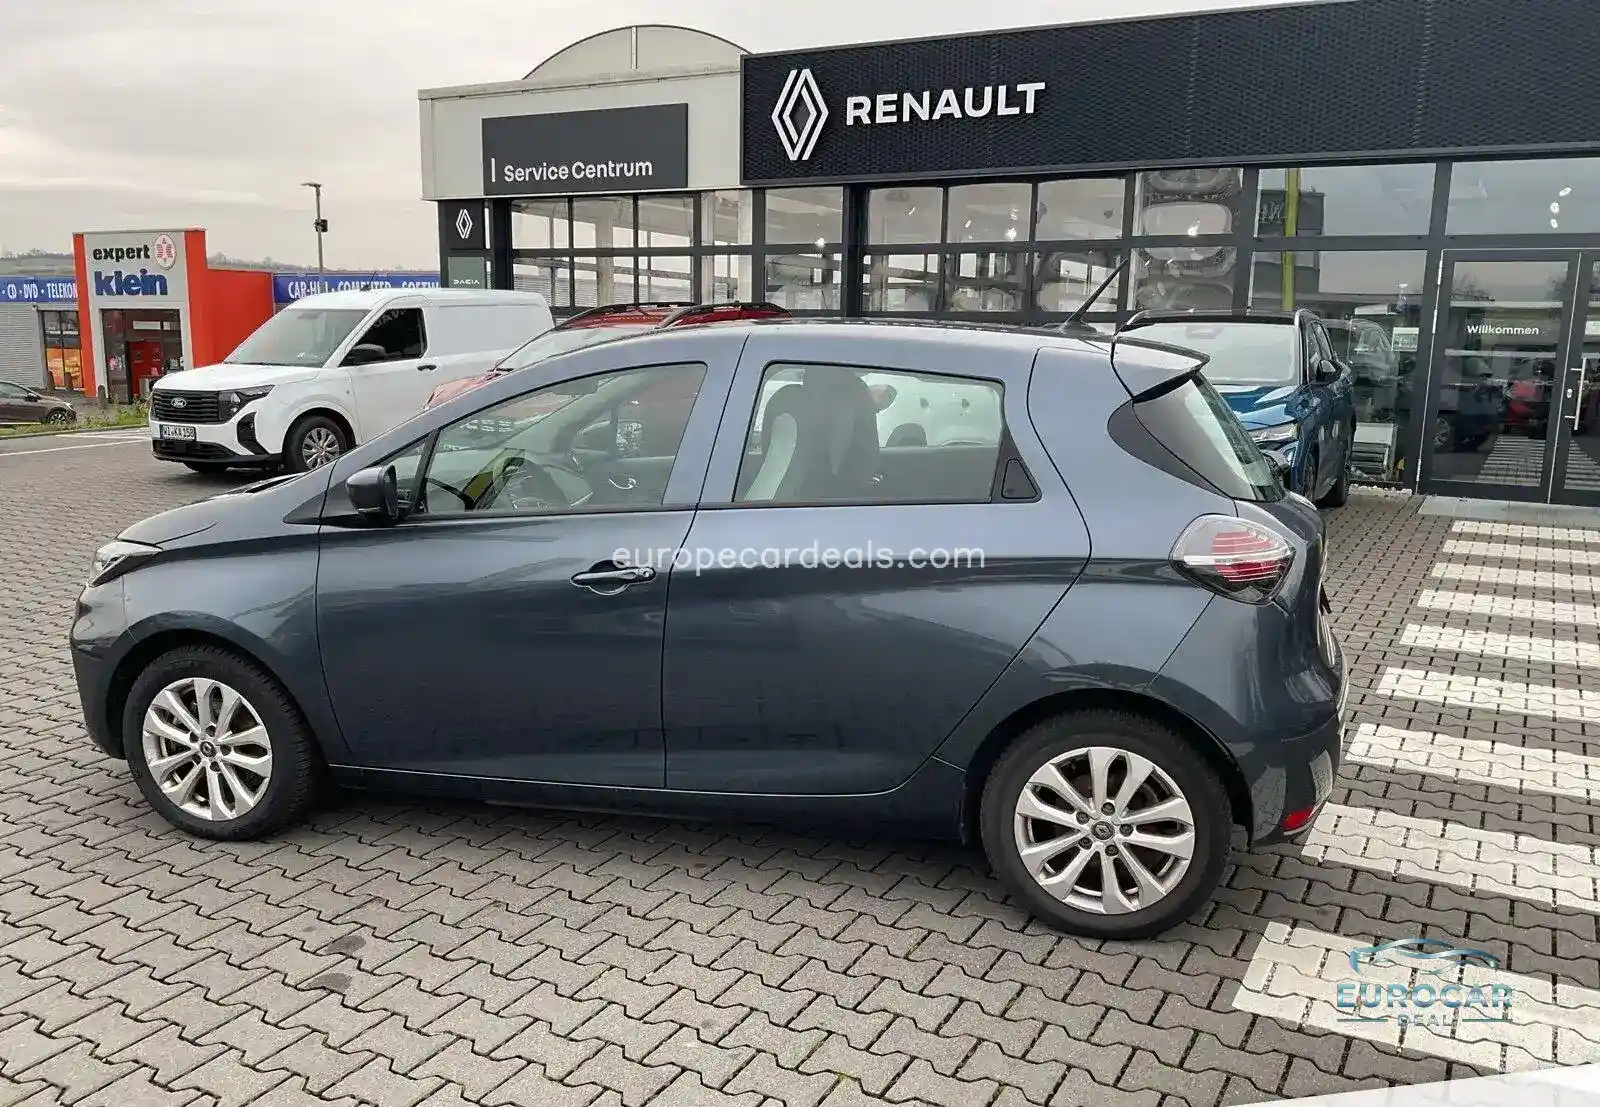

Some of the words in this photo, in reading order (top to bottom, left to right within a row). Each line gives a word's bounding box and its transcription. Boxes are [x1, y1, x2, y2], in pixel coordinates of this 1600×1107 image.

[846, 82, 1046, 126] RENAULT
[504, 162, 569, 182] Service
[571, 160, 653, 179] Centrum
[93, 244, 150, 262] expert
[7, 284, 17, 299] CD
[23, 284, 38, 298] DVD
[94, 268, 168, 296] klein
[1467, 324, 1539, 335] Willkommen
